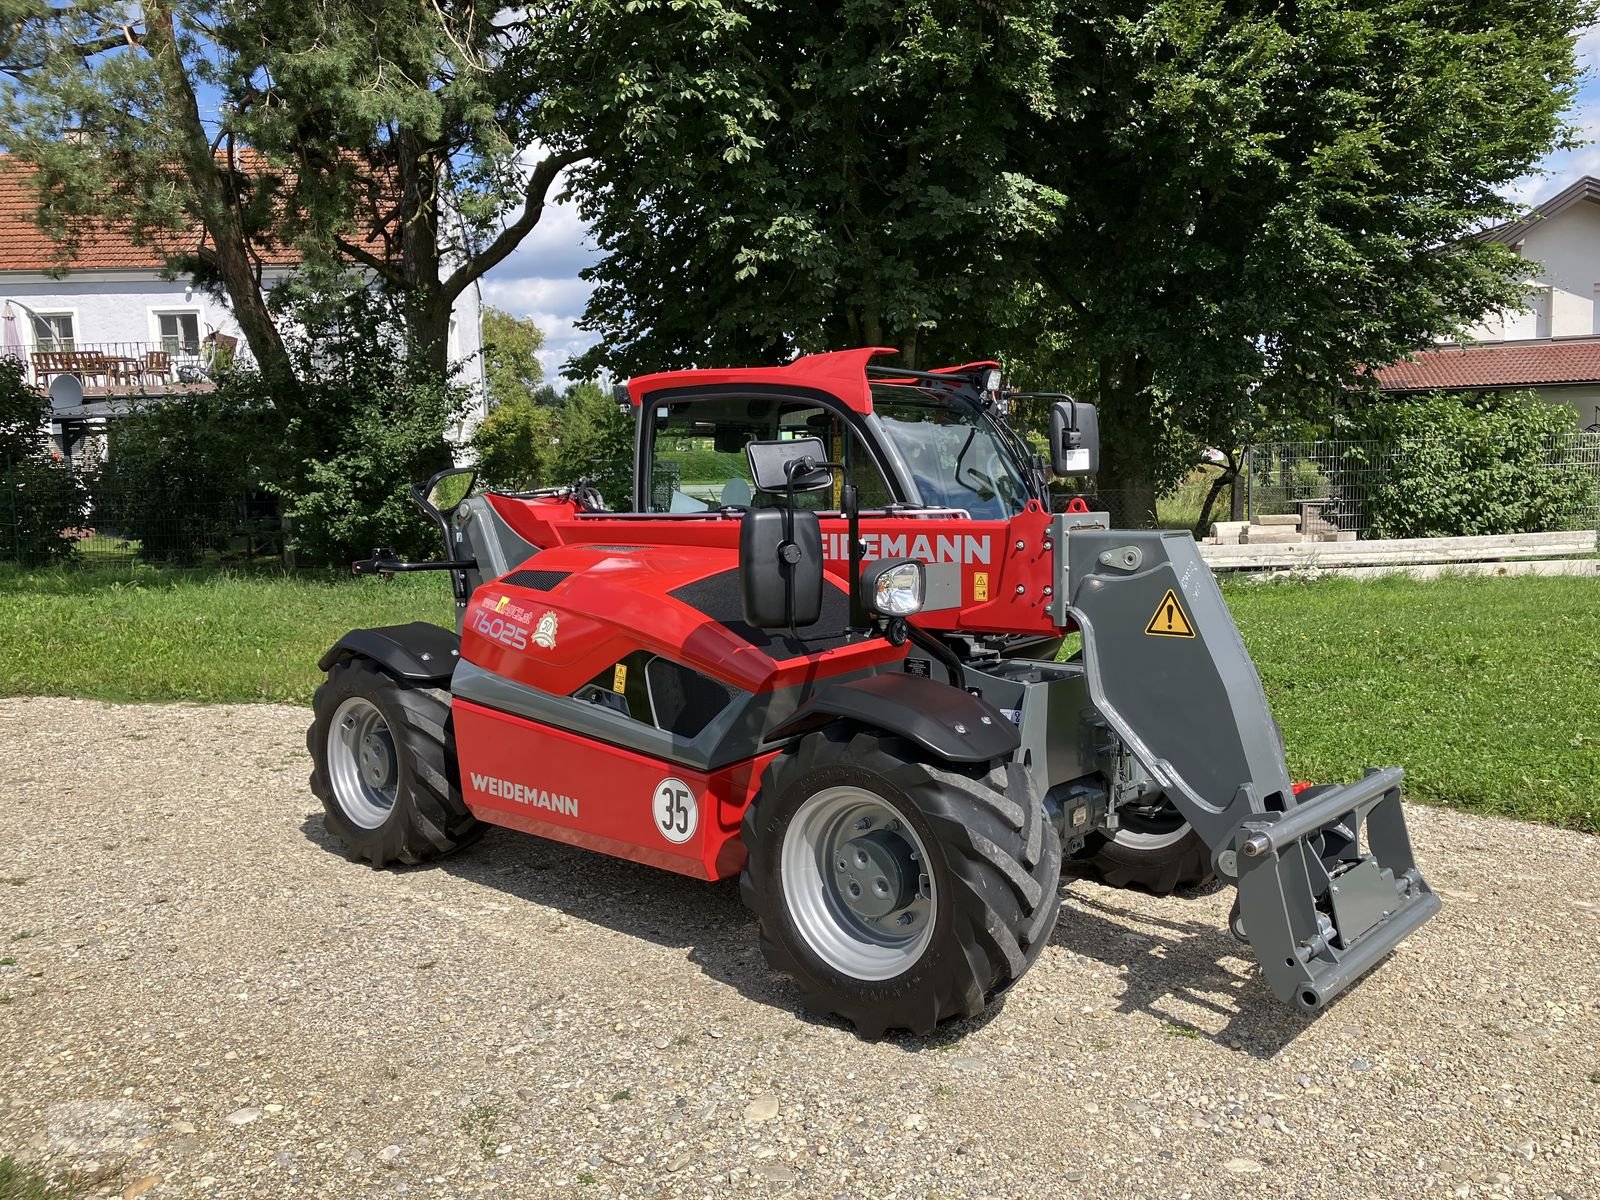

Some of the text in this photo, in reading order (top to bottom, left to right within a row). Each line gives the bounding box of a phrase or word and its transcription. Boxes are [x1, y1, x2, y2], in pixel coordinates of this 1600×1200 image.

[473, 608, 528, 650] T6025
[541, 619, 553, 633] 50
[470, 772, 579, 817] WEIDEMANN
[662, 787, 689, 834] 35
